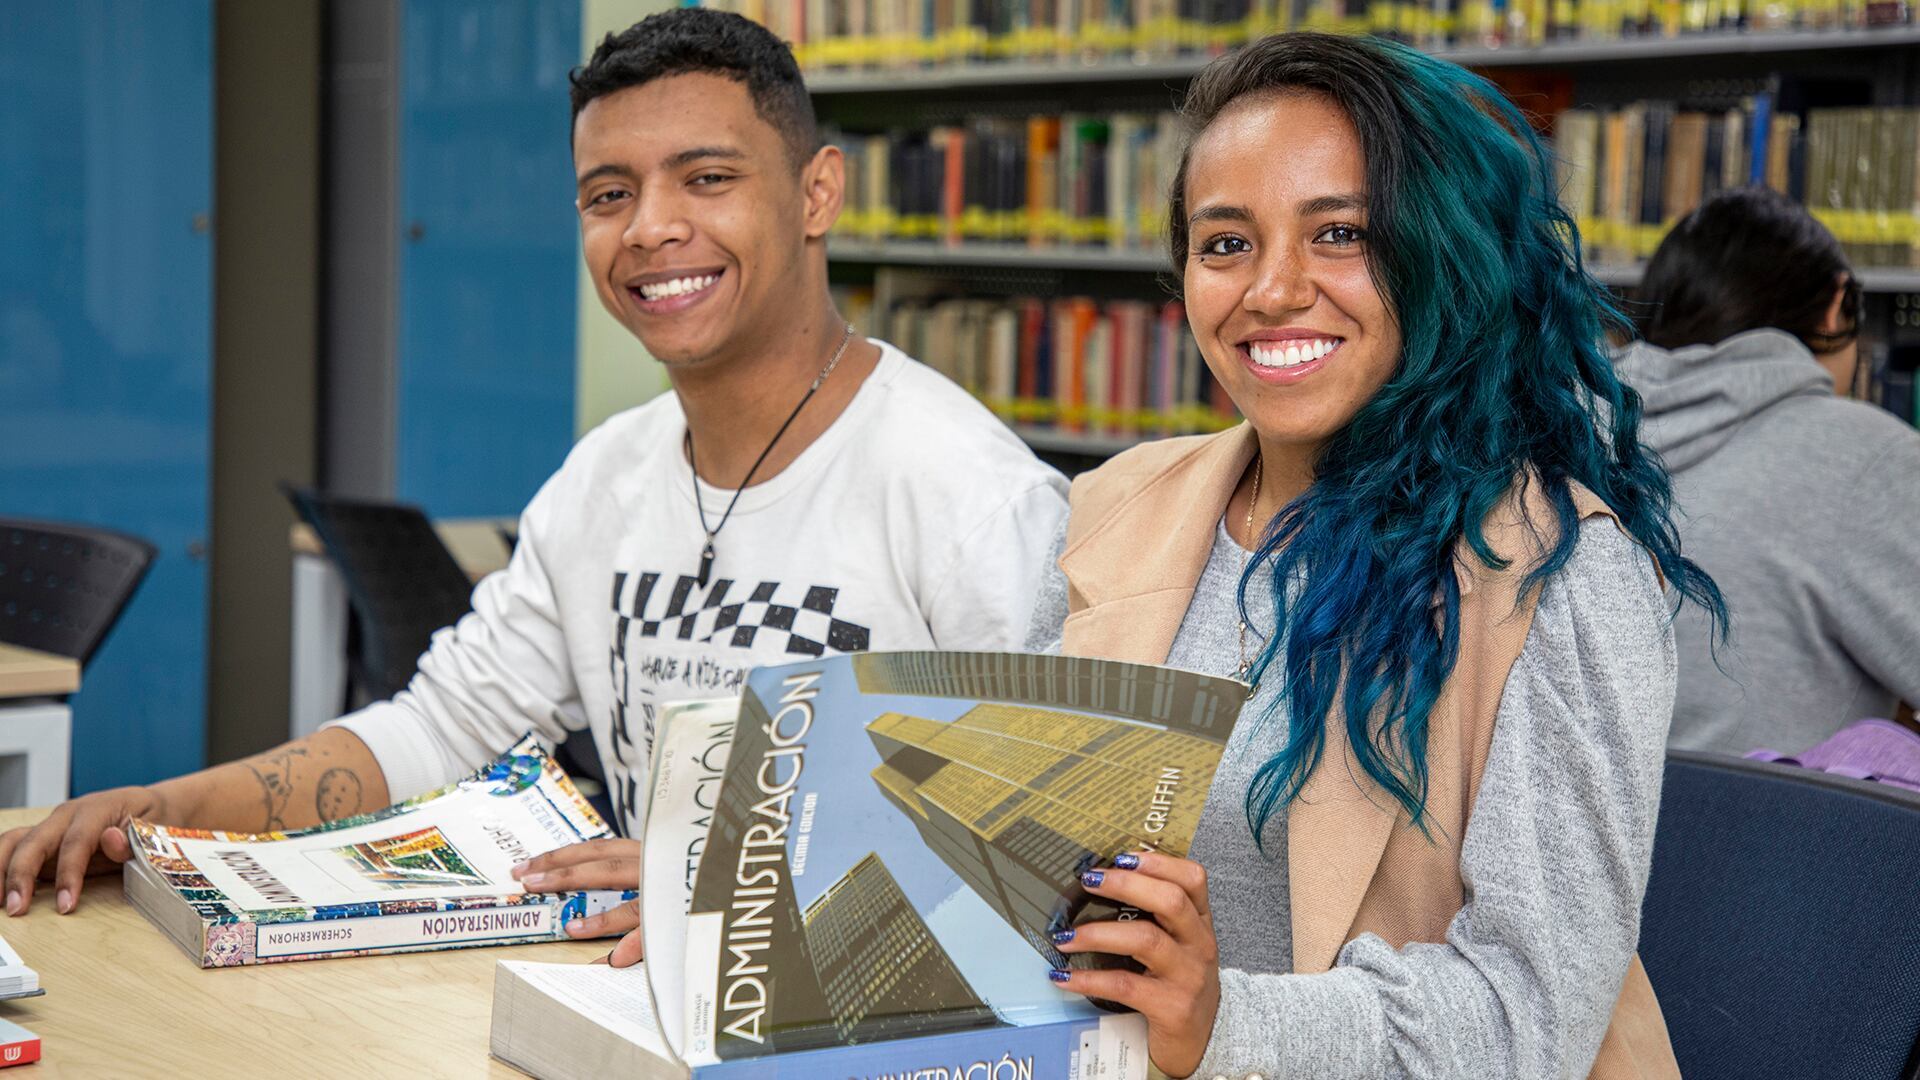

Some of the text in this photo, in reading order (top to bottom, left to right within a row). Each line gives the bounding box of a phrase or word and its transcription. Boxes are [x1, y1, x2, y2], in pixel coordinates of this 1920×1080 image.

[641, 656, 678, 684] HAVE
[682, 660, 691, 687] A
[1144, 767, 1182, 833] GRIFFIN
[208, 851, 306, 903] ADMINISTRACIÓN
[723, 672, 823, 1044] ADMINISTRACIÓN
[269, 928, 353, 945] SCHERMERHORN
[423, 911, 541, 938] ADMINISTRACIÓN
[693, 993, 703, 1037] CENGAGE
